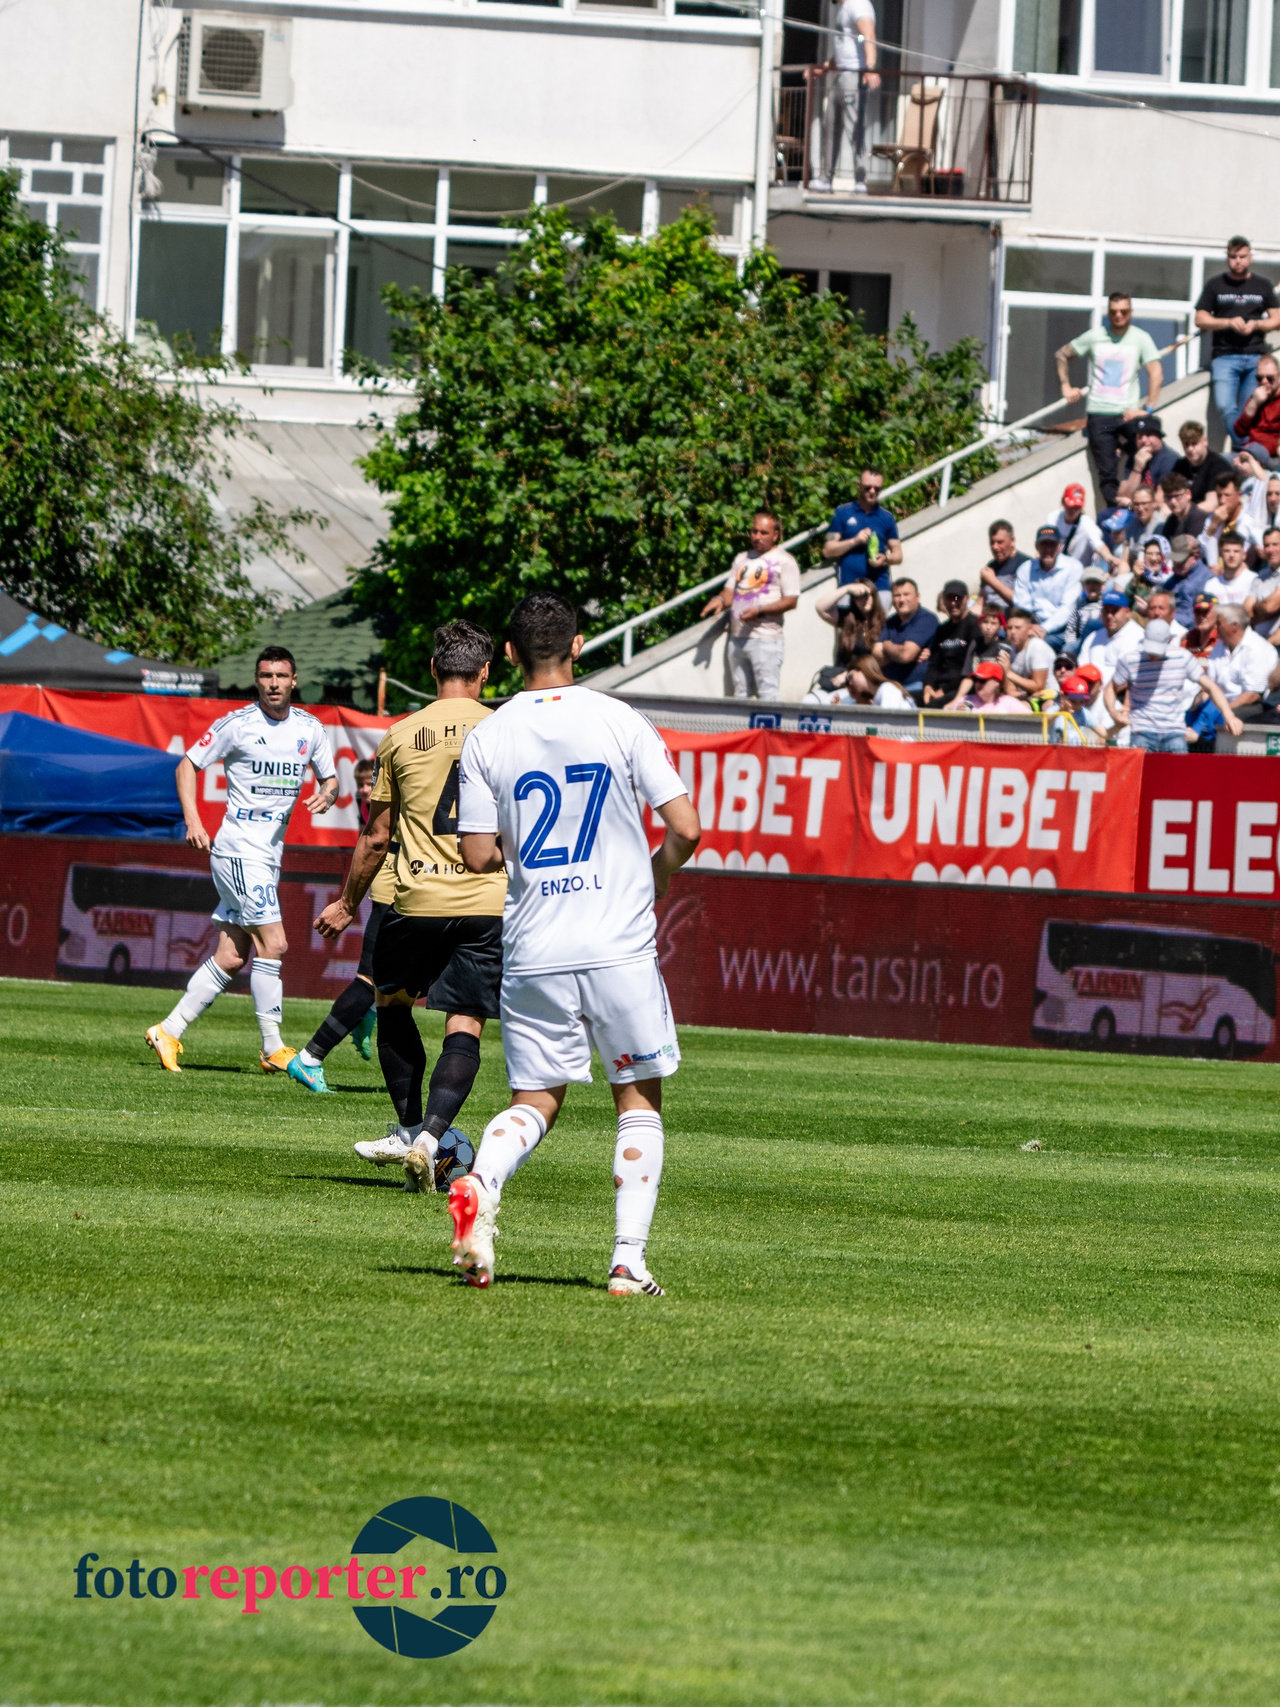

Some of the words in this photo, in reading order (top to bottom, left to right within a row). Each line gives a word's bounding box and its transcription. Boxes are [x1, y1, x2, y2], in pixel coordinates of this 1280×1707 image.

[514, 763, 612, 869] 27
[640, 750, 841, 838] IBET
[870, 762, 1106, 852] UNIBET
[253, 884, 276, 908] 30
[719, 943, 1004, 1008] www.tarsin.ro
[632, 1049, 661, 1062] Smart
